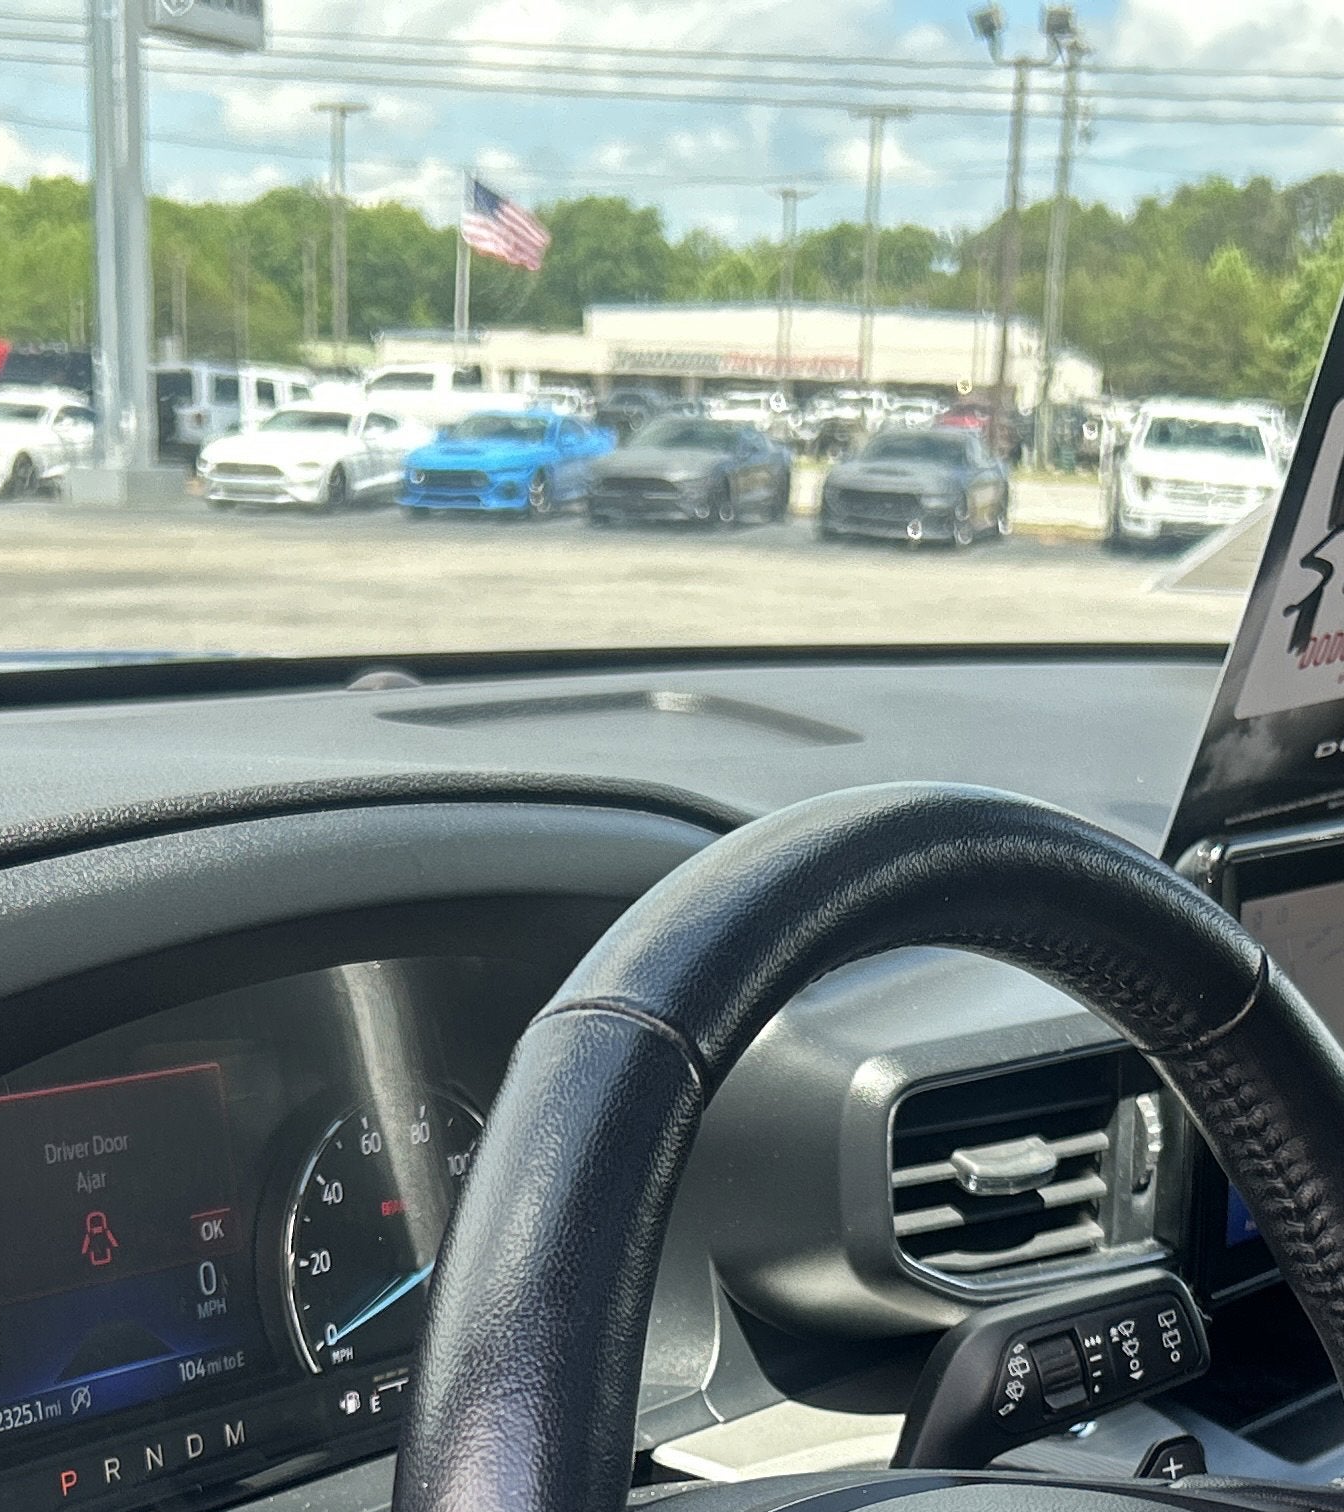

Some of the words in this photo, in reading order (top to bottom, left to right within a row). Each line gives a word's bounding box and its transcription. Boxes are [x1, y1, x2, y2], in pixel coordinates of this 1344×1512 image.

[361, 1131, 381, 1155] 60
[411, 1121, 430, 1145] 80
[44, 1141, 89, 1165] Driver
[93, 1135, 128, 1155] Door
[77, 1171, 106, 1194] Ajar
[322, 1181, 344, 1205] 40
[200, 1219, 225, 1241] OK
[310, 1250, 331, 1275] 20
[198, 1260, 217, 1296] 0
[196, 1297, 227, 1320] MPH
[331, 1346, 354, 1365] MPH
[178, 1358, 206, 1383] 104
[369, 1393, 381, 1414] E
